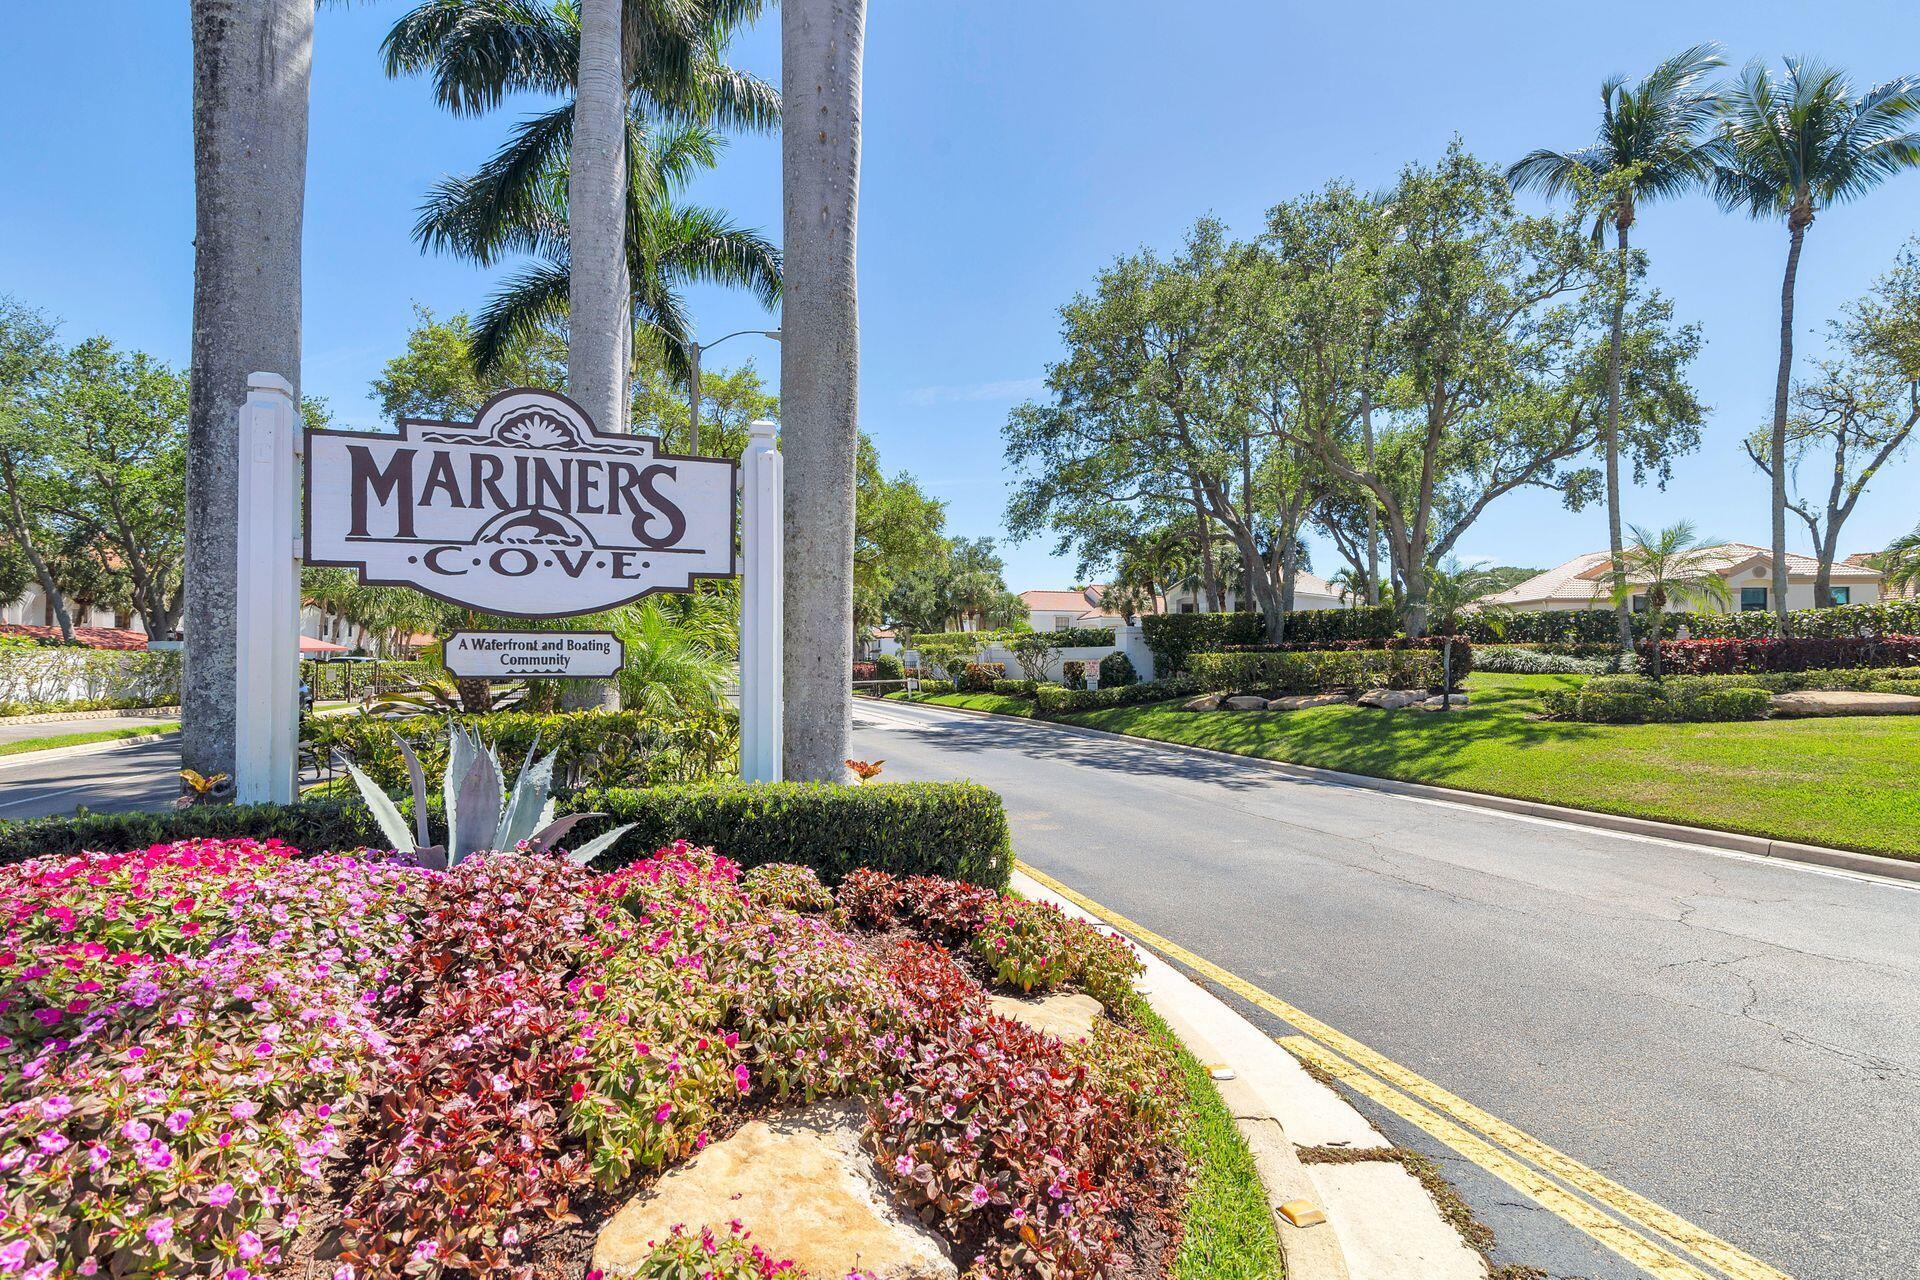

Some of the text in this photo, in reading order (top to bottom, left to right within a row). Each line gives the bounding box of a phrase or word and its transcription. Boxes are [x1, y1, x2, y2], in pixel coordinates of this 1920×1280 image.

[346, 444, 687, 548] MARINERS
[458, 638, 611, 654] A Waterfront and Boating
[500, 653, 571, 668] Community
